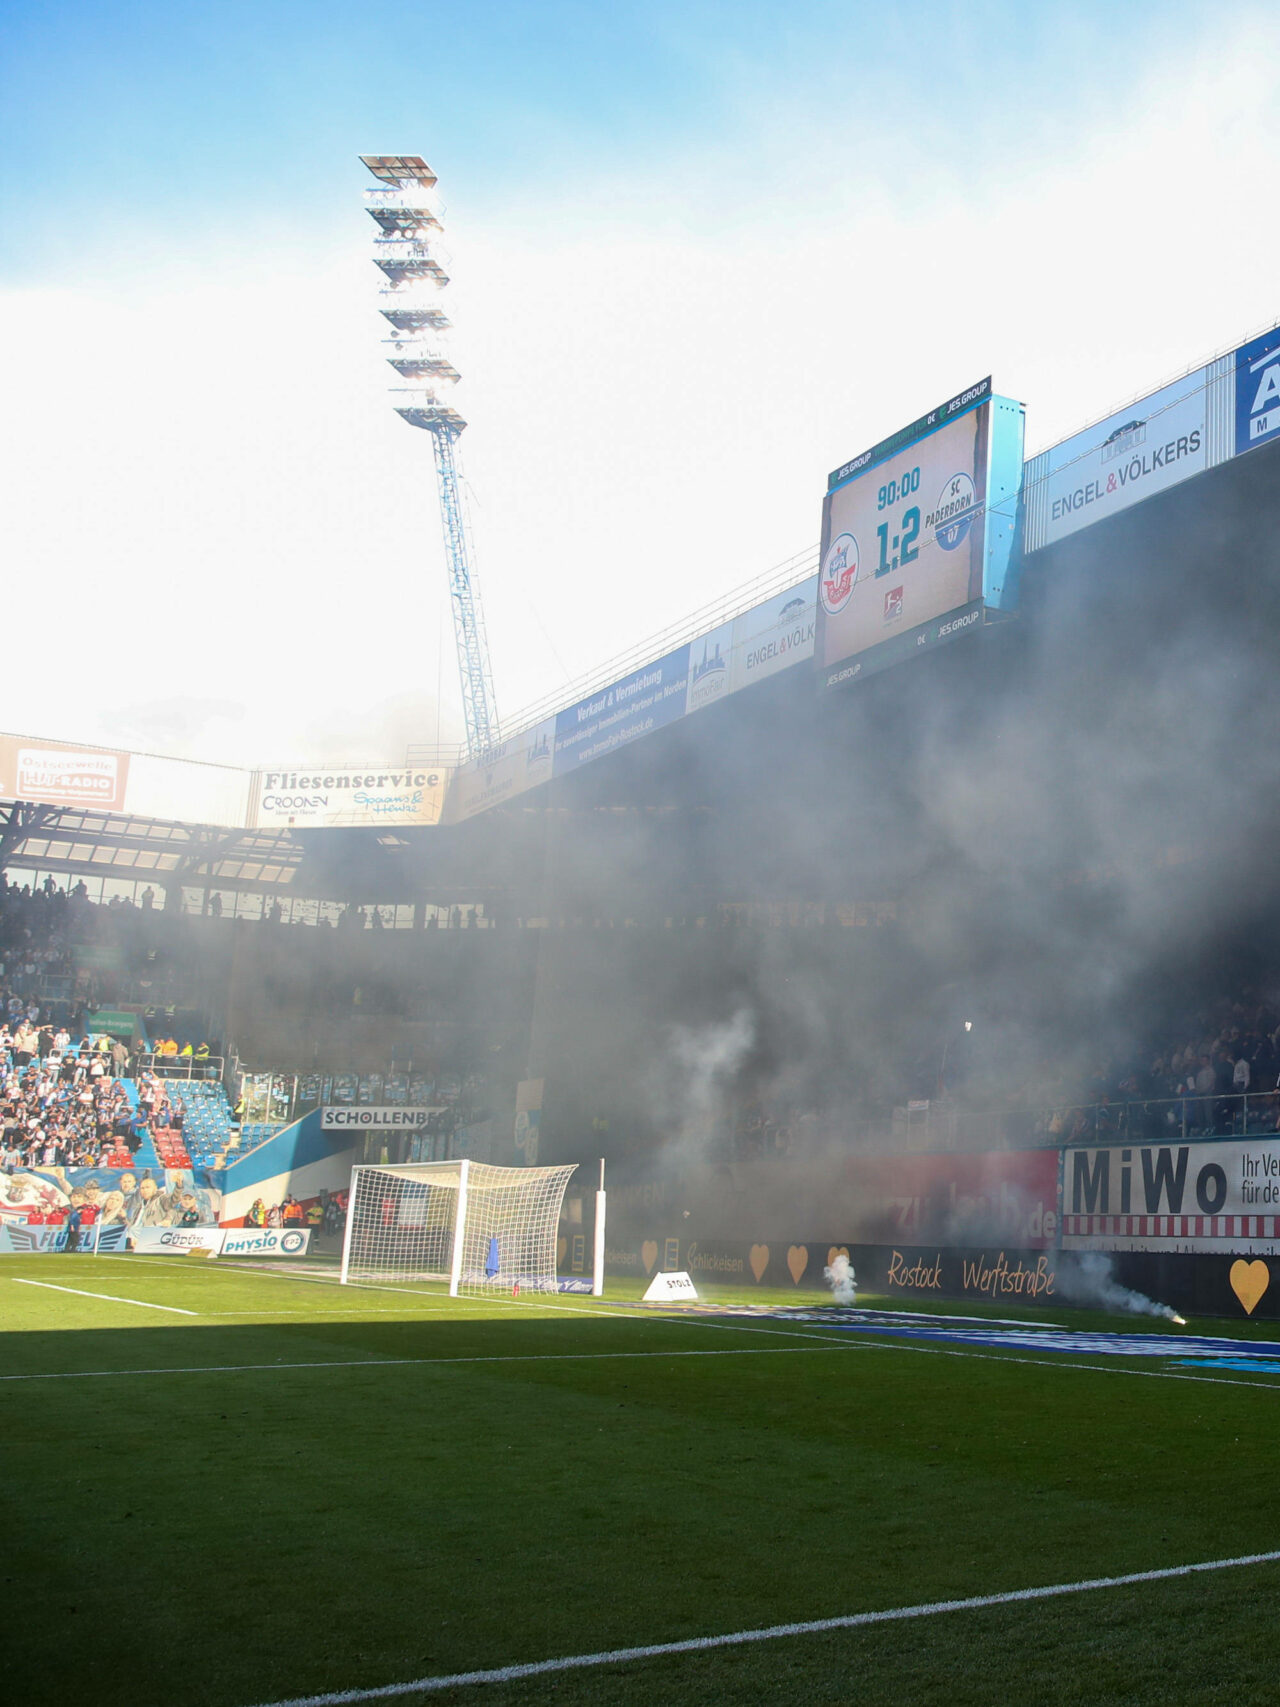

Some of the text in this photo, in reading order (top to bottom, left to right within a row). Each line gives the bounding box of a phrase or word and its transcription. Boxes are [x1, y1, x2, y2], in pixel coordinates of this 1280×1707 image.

[878, 467, 920, 511] 90:00
[951, 479, 960, 496] SC
[925, 491, 972, 528] PADERBORN
[875, 506, 920, 579] 1:2
[615, 668, 662, 702] Vermietung
[264, 771, 439, 790] Fliesenservice
[1073, 1147, 1227, 1215] MiWo
[1242, 1154, 1259, 1177] Ihr
[1242, 1179, 1262, 1204] für
[226, 1237, 277, 1252] PHYSIO
[888, 1250, 942, 1289] Rostock
